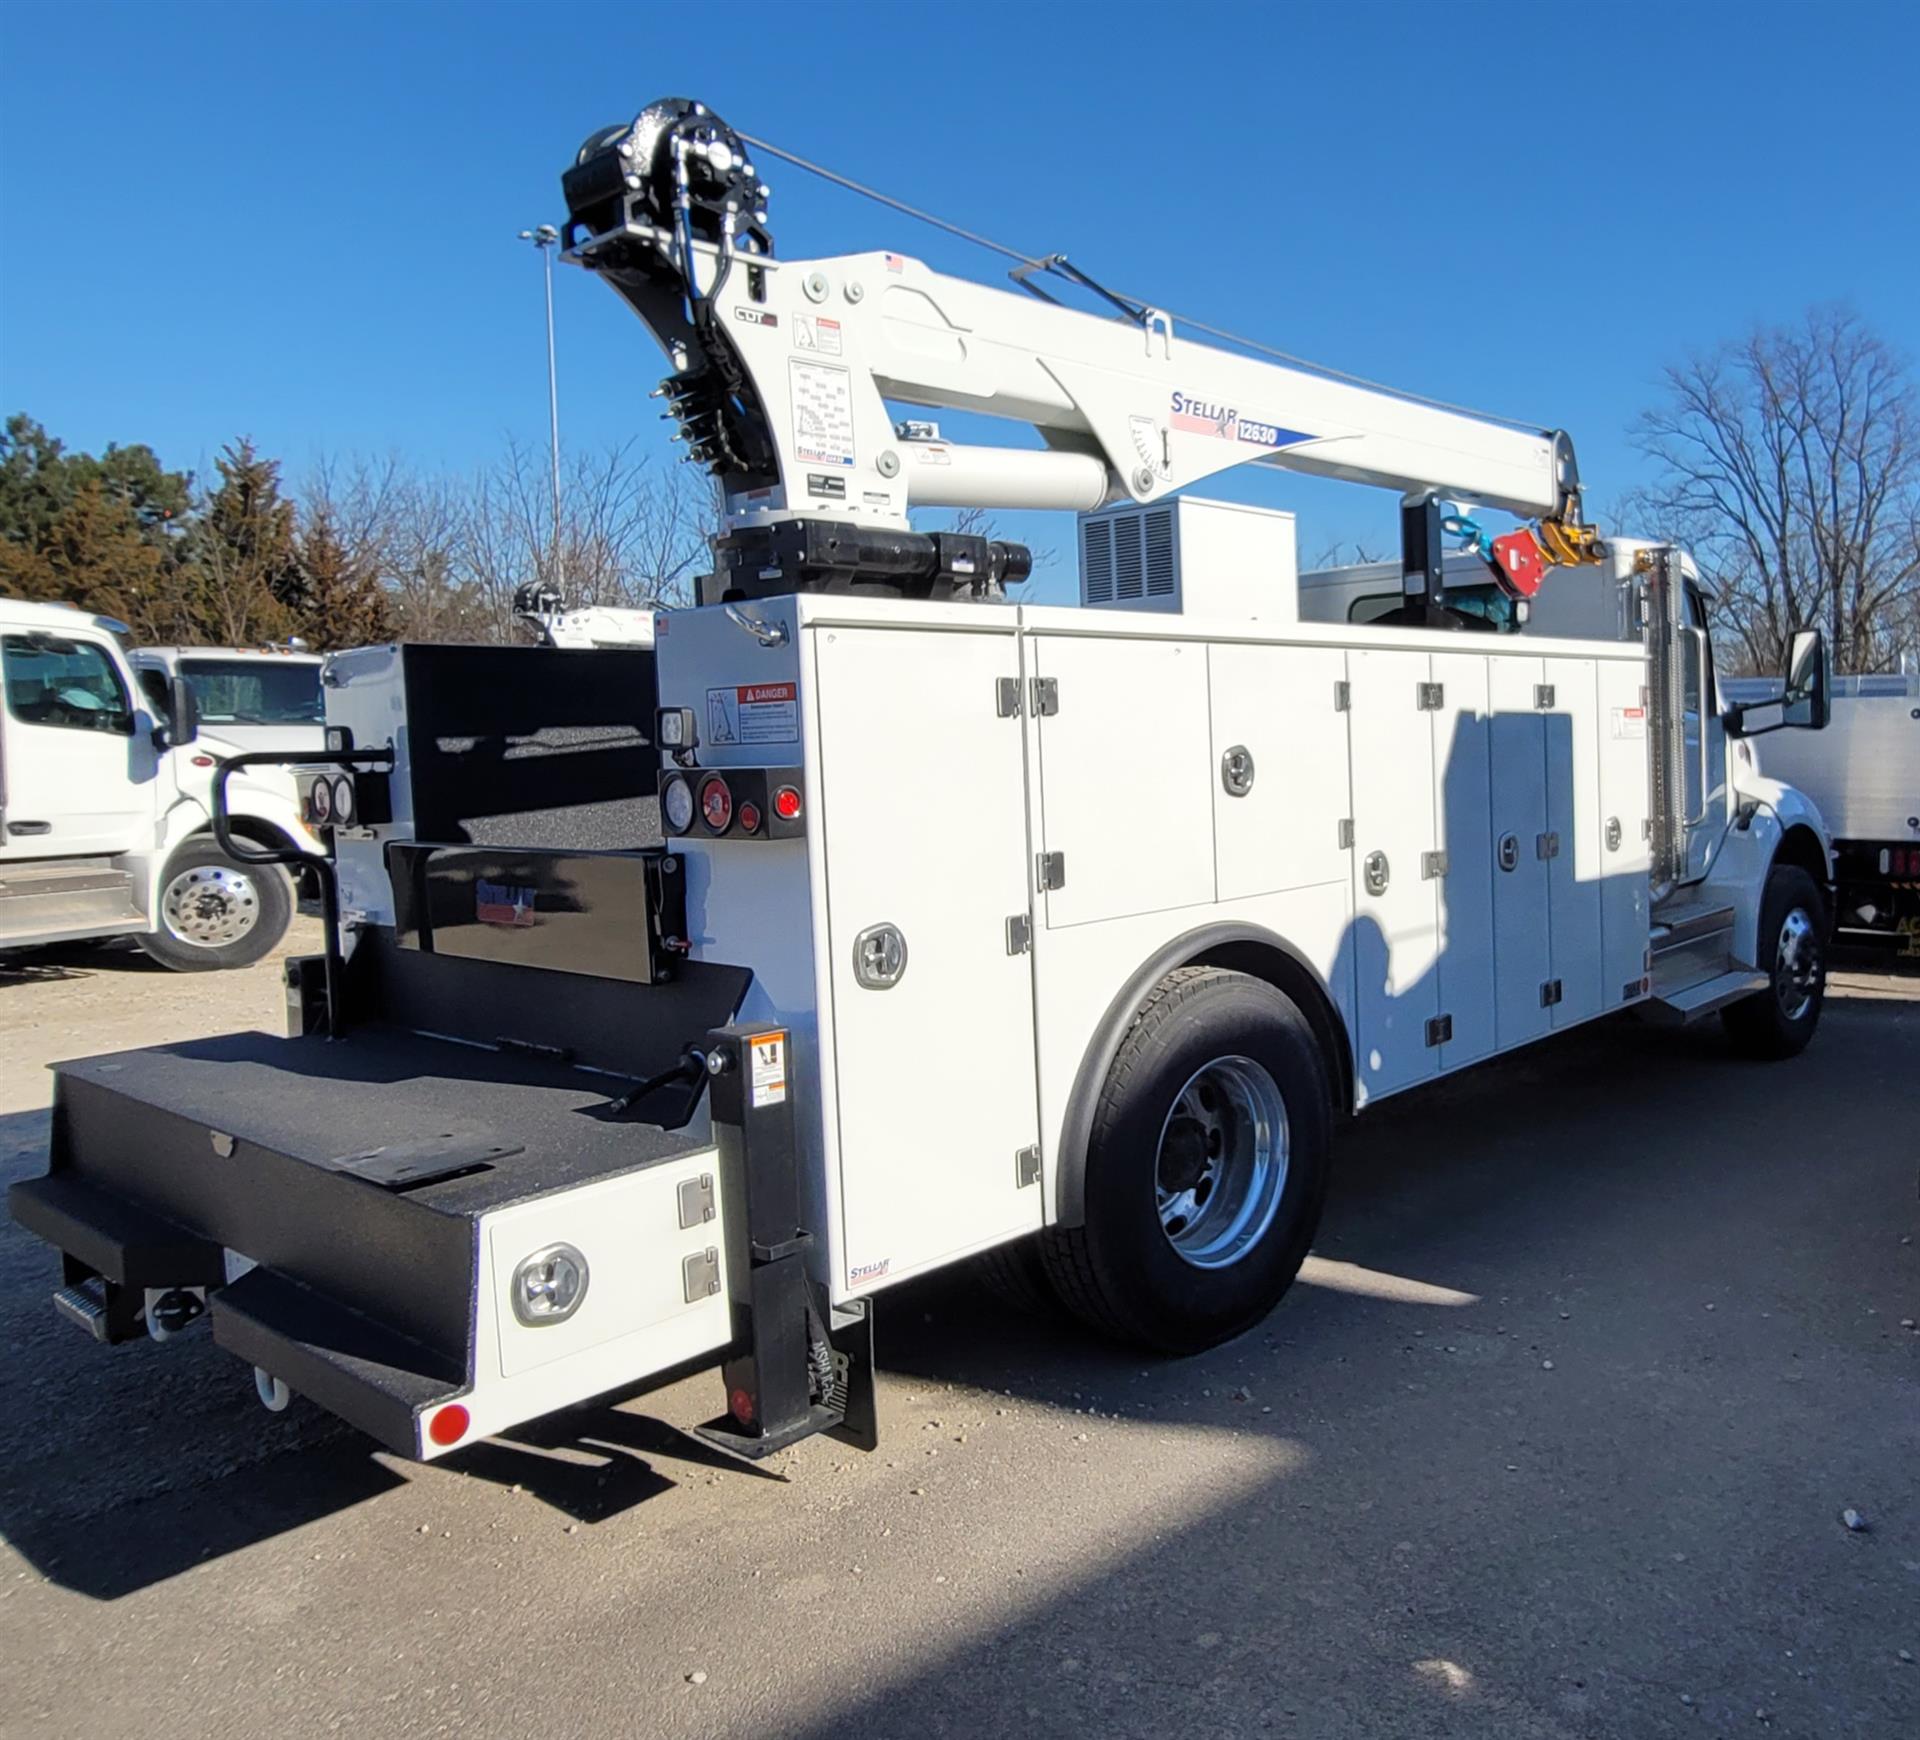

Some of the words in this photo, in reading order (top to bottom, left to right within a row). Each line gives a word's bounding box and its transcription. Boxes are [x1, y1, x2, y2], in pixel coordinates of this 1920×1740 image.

[1170, 391, 1237, 425] STELLAR
[1239, 422, 1277, 444] 12630
[755, 687, 788, 700] DANGER
[850, 1257, 890, 1279] STELLAR
